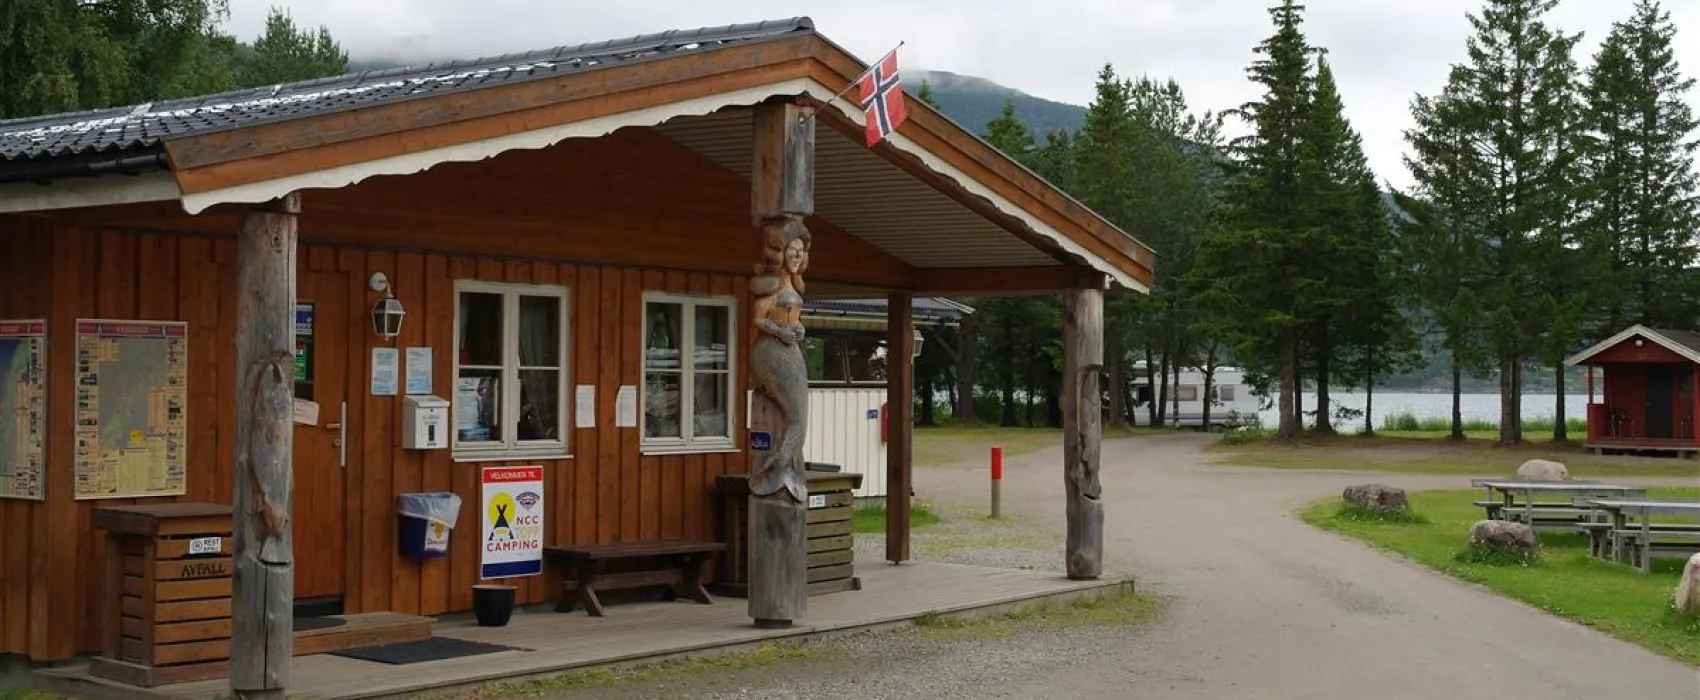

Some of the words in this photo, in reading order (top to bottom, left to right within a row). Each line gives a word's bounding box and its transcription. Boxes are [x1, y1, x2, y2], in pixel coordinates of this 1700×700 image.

[490, 471, 526, 480] VELKOMMEN
[516, 515, 539, 525] NCC
[487, 540, 538, 551] CAMPING
[181, 563, 226, 577] AVFALL
